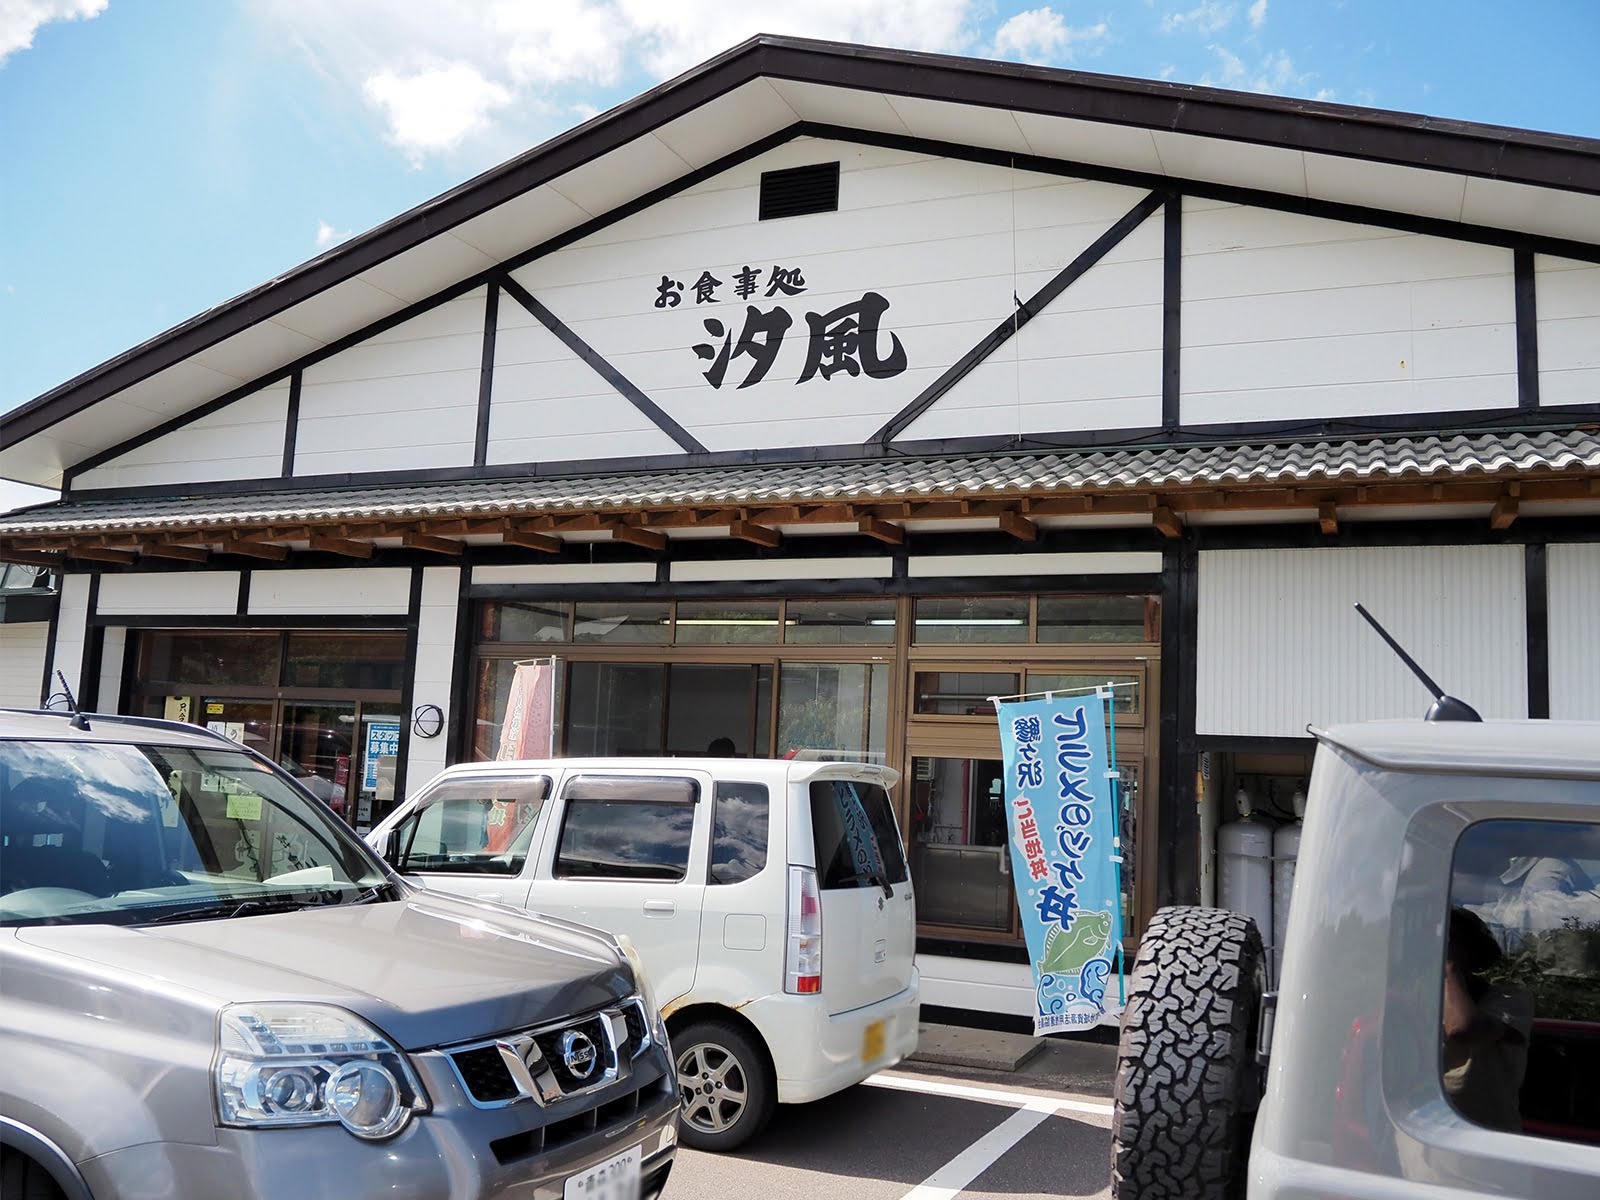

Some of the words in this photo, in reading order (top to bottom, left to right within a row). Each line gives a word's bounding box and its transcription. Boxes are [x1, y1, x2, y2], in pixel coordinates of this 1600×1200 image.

[654, 265, 808, 308] お食事処
[692, 292, 908, 390] 汐風
[370, 741, 399, 755] 募集中
